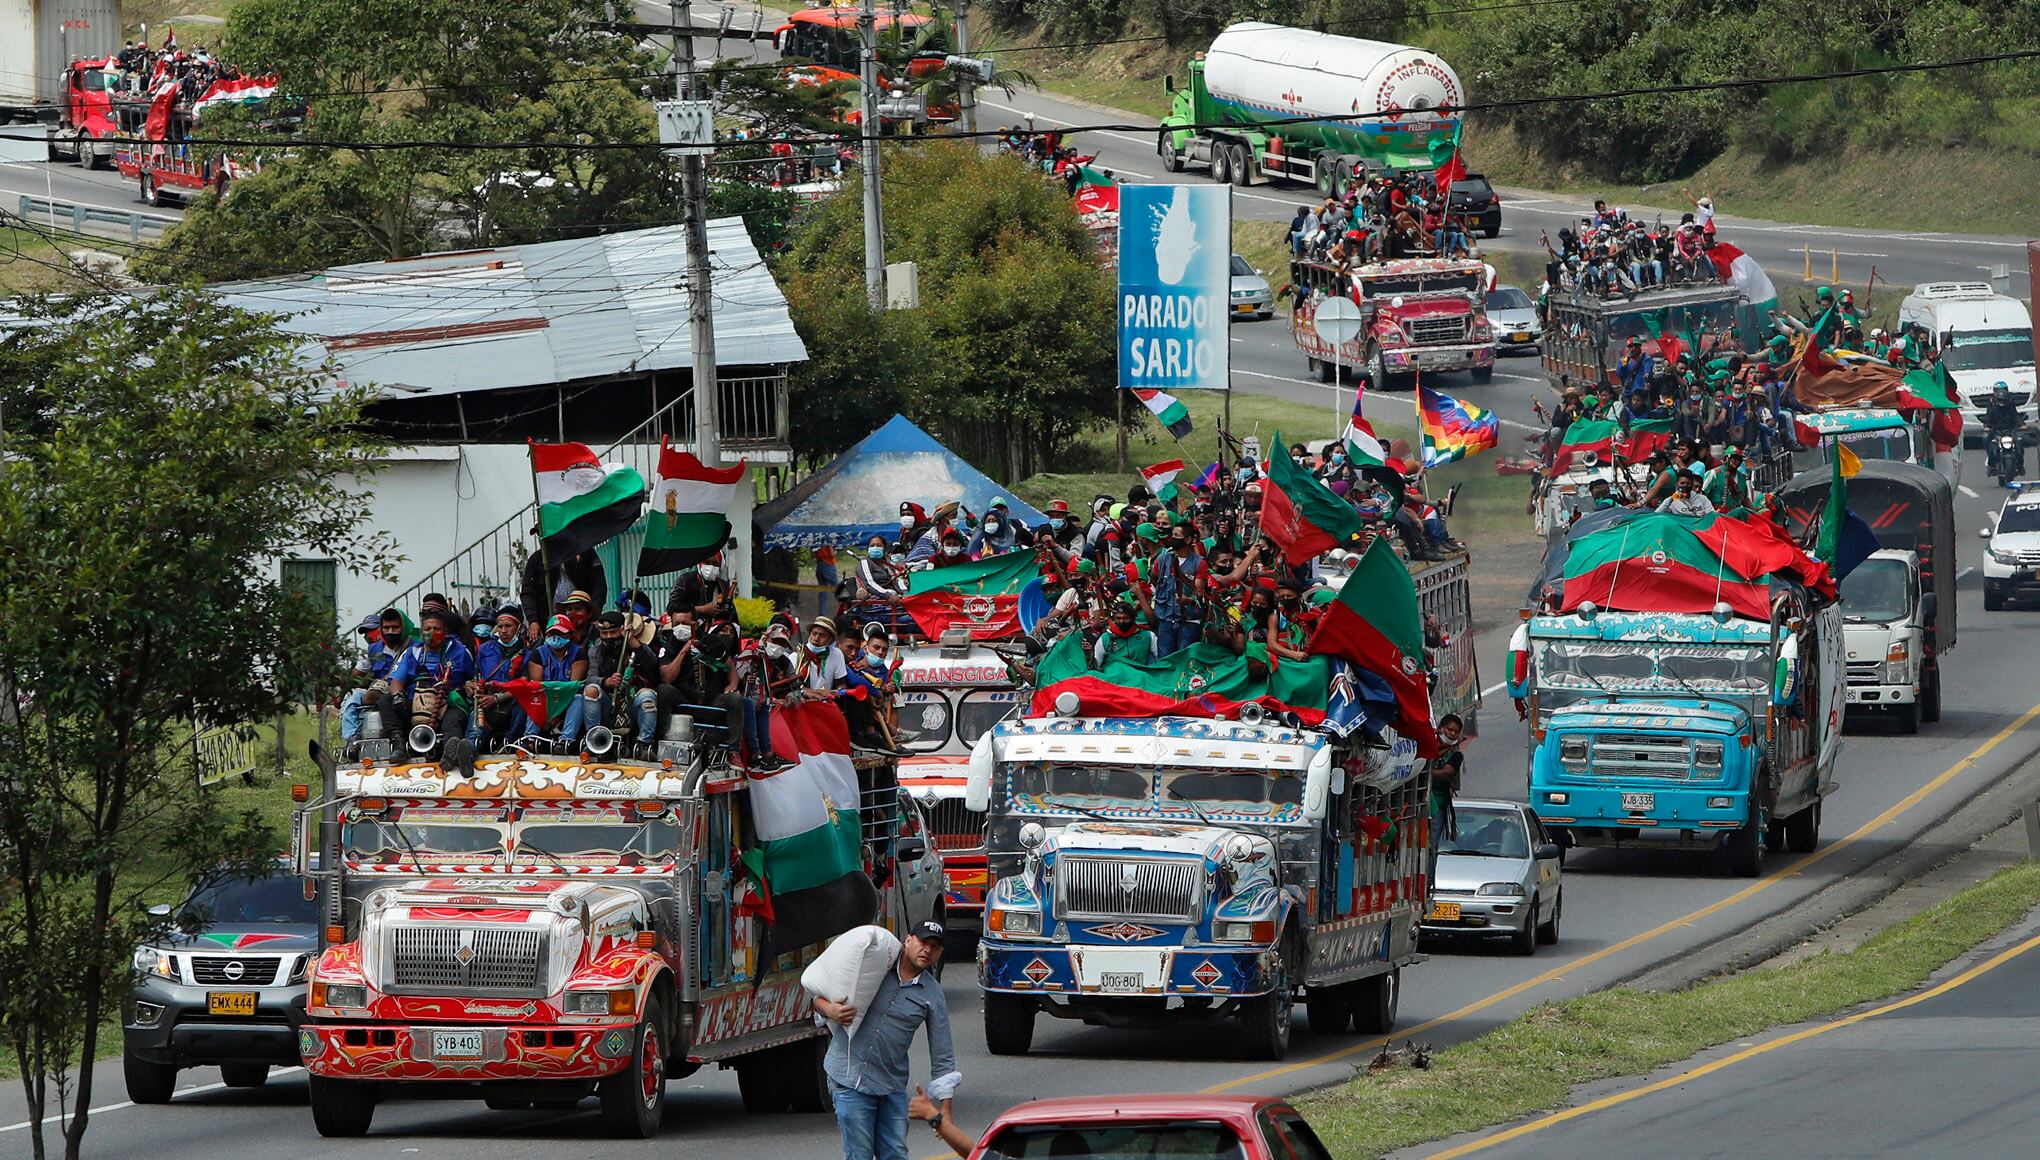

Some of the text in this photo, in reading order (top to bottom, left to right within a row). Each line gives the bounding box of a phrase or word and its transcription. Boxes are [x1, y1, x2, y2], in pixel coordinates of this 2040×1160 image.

[1382, 66, 1454, 107] GAS INFLAMABLE
[1131, 337, 1214, 378] SARJO
[969, 603, 988, 613] CRIC
